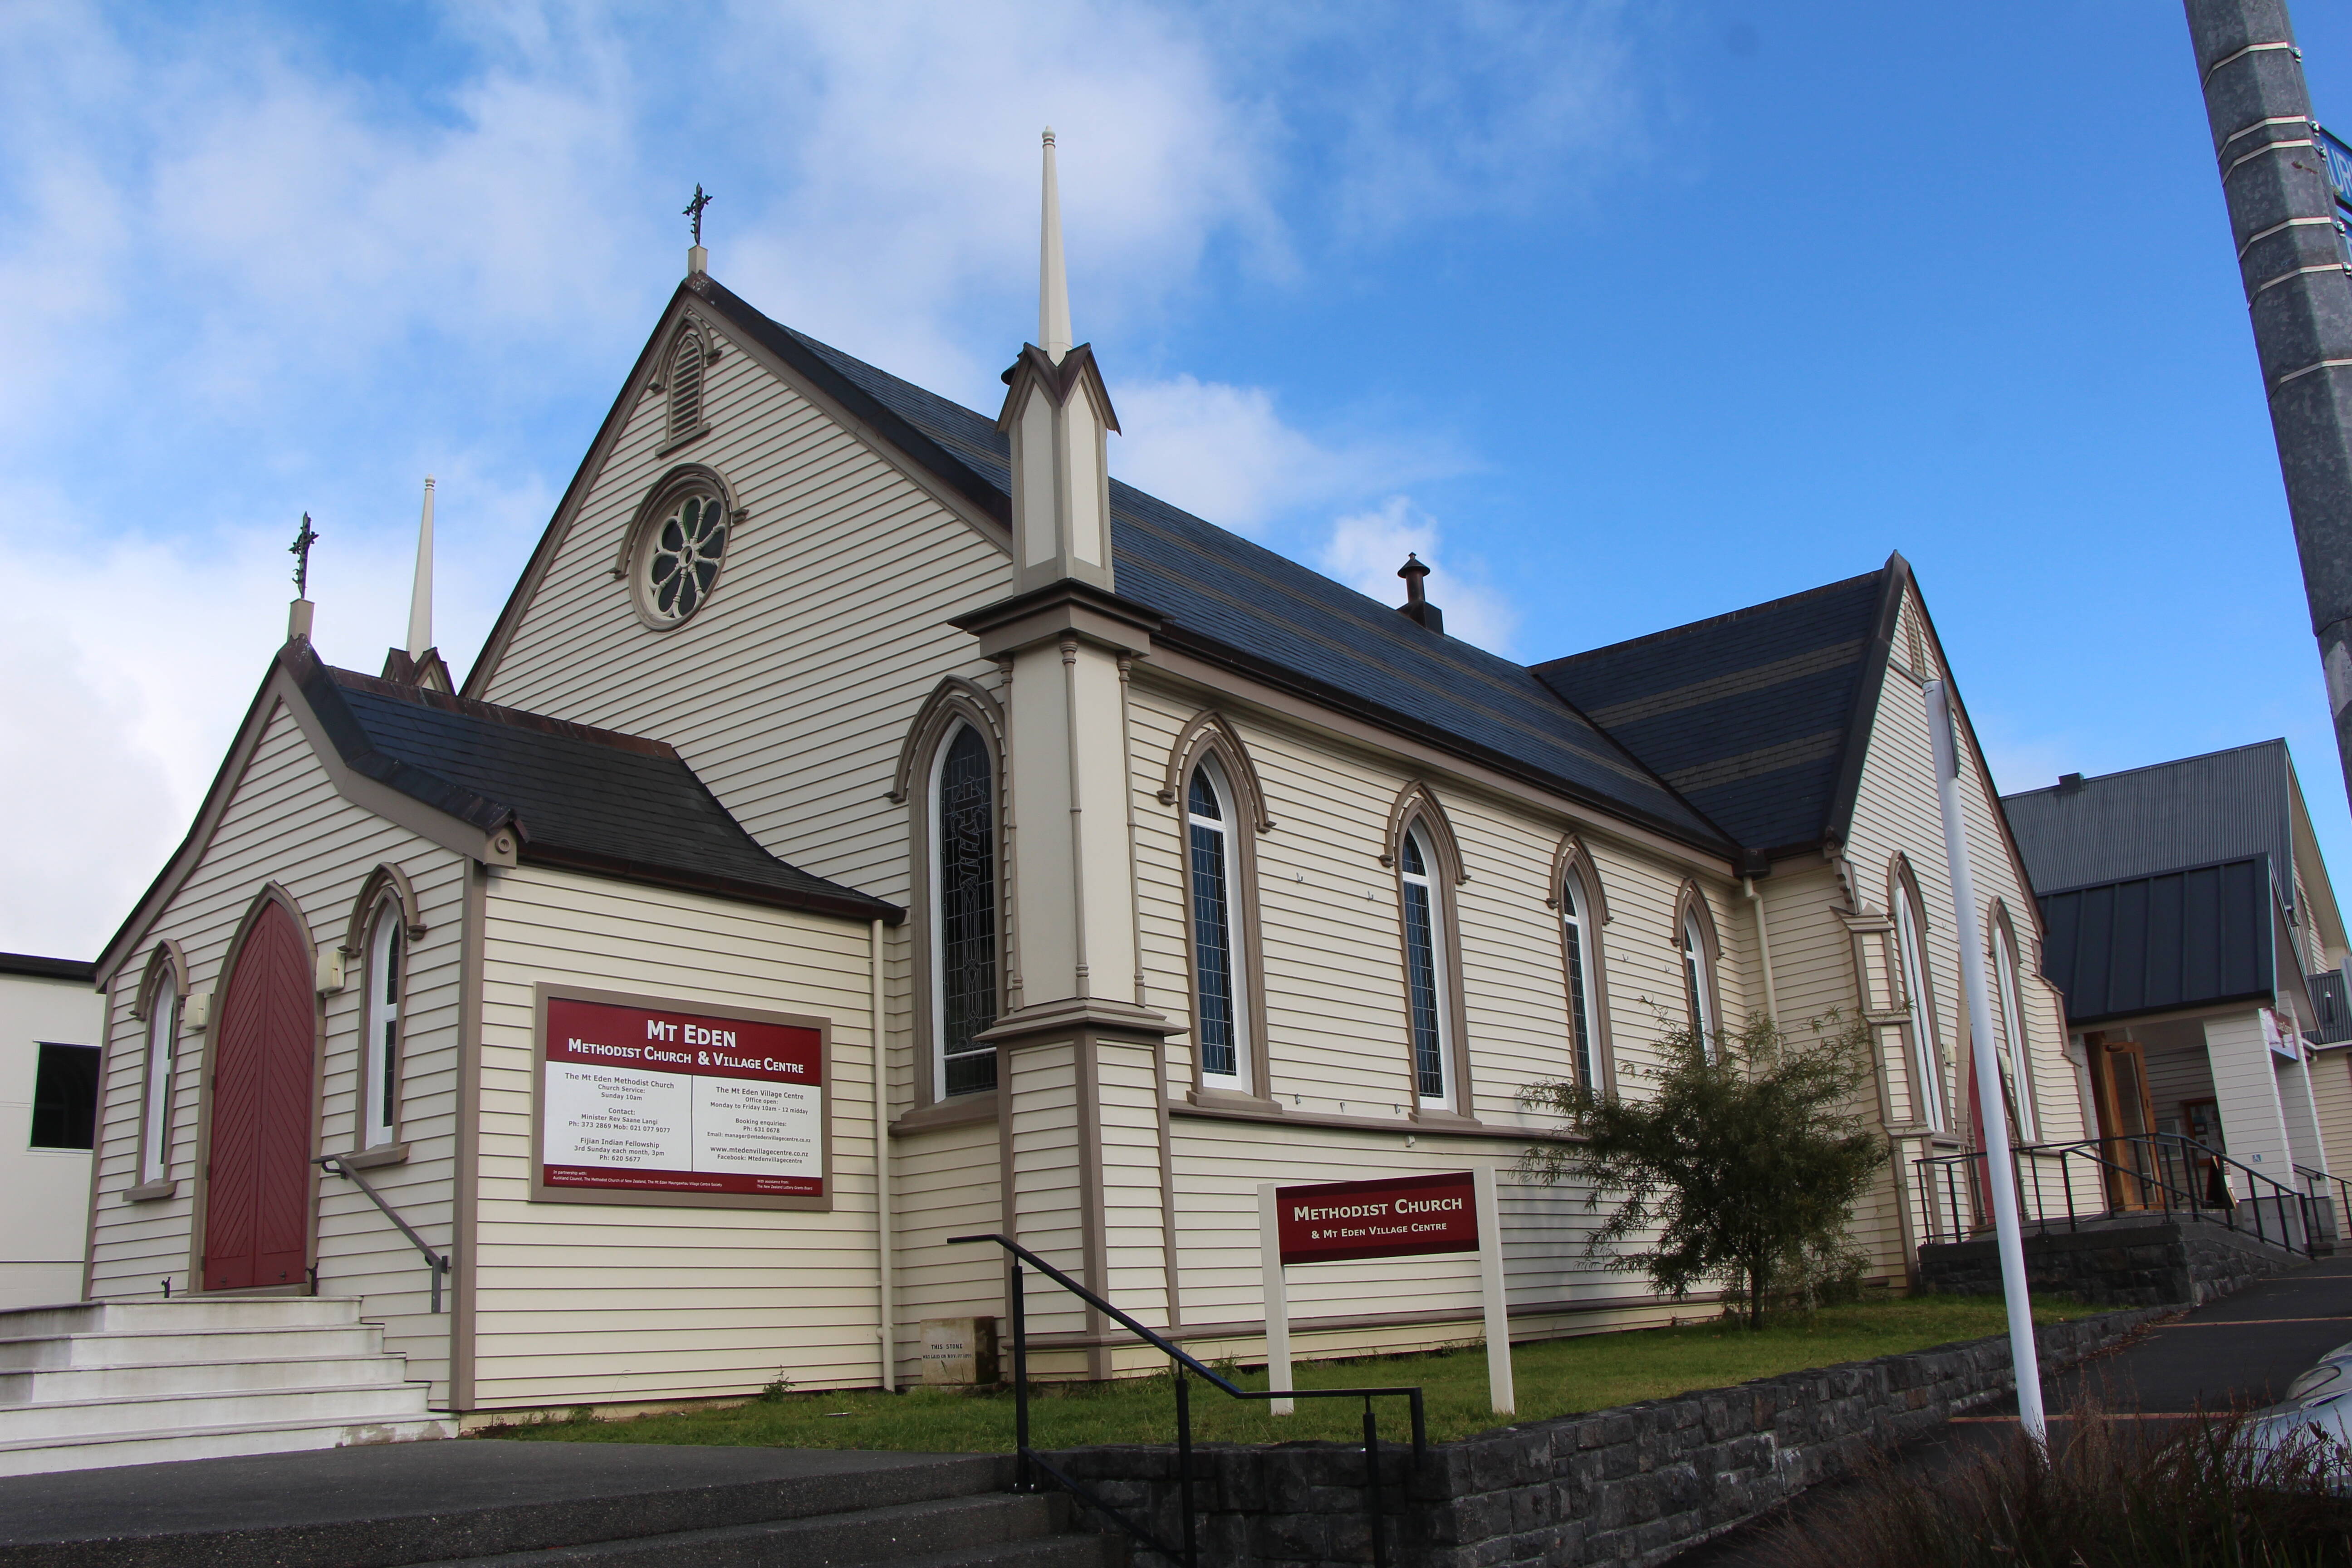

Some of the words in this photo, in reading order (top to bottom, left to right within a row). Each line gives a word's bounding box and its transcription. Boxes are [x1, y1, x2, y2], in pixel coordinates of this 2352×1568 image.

[647, 1019, 677, 1042] MT
[684, 1024, 736, 1048] EDEN
[568, 1038, 641, 1058] METHODIST
[644, 1045, 691, 1064] CHURCH
[697, 1051, 710, 1066] &
[712, 1052, 761, 1070] VILLAGE
[764, 1057, 804, 1074] CENTRE
[614, 1077, 648, 1086] Methodist
[651, 1081, 675, 1089] Church
[725, 1133, 811, 1143] manager@mtedenvillagecentre.co.nz
[625, 1140, 660, 1149] Fellowship
[710, 1146, 808, 1157] www.mtedenvillagecentre.co.nz
[748, 1156, 803, 1164] Mtedenvillagecentre
[1294, 1203, 1388, 1221] METHODIST
[1395, 1198, 1463, 1214] CHURCH
[1311, 1230, 1320, 1239] &
[1323, 1229, 1338, 1238] MT
[1342, 1227, 1366, 1238] EDEN
[1369, 1225, 1408, 1235] VILLAGE
[1411, 1222, 1447, 1232] CENTRE
